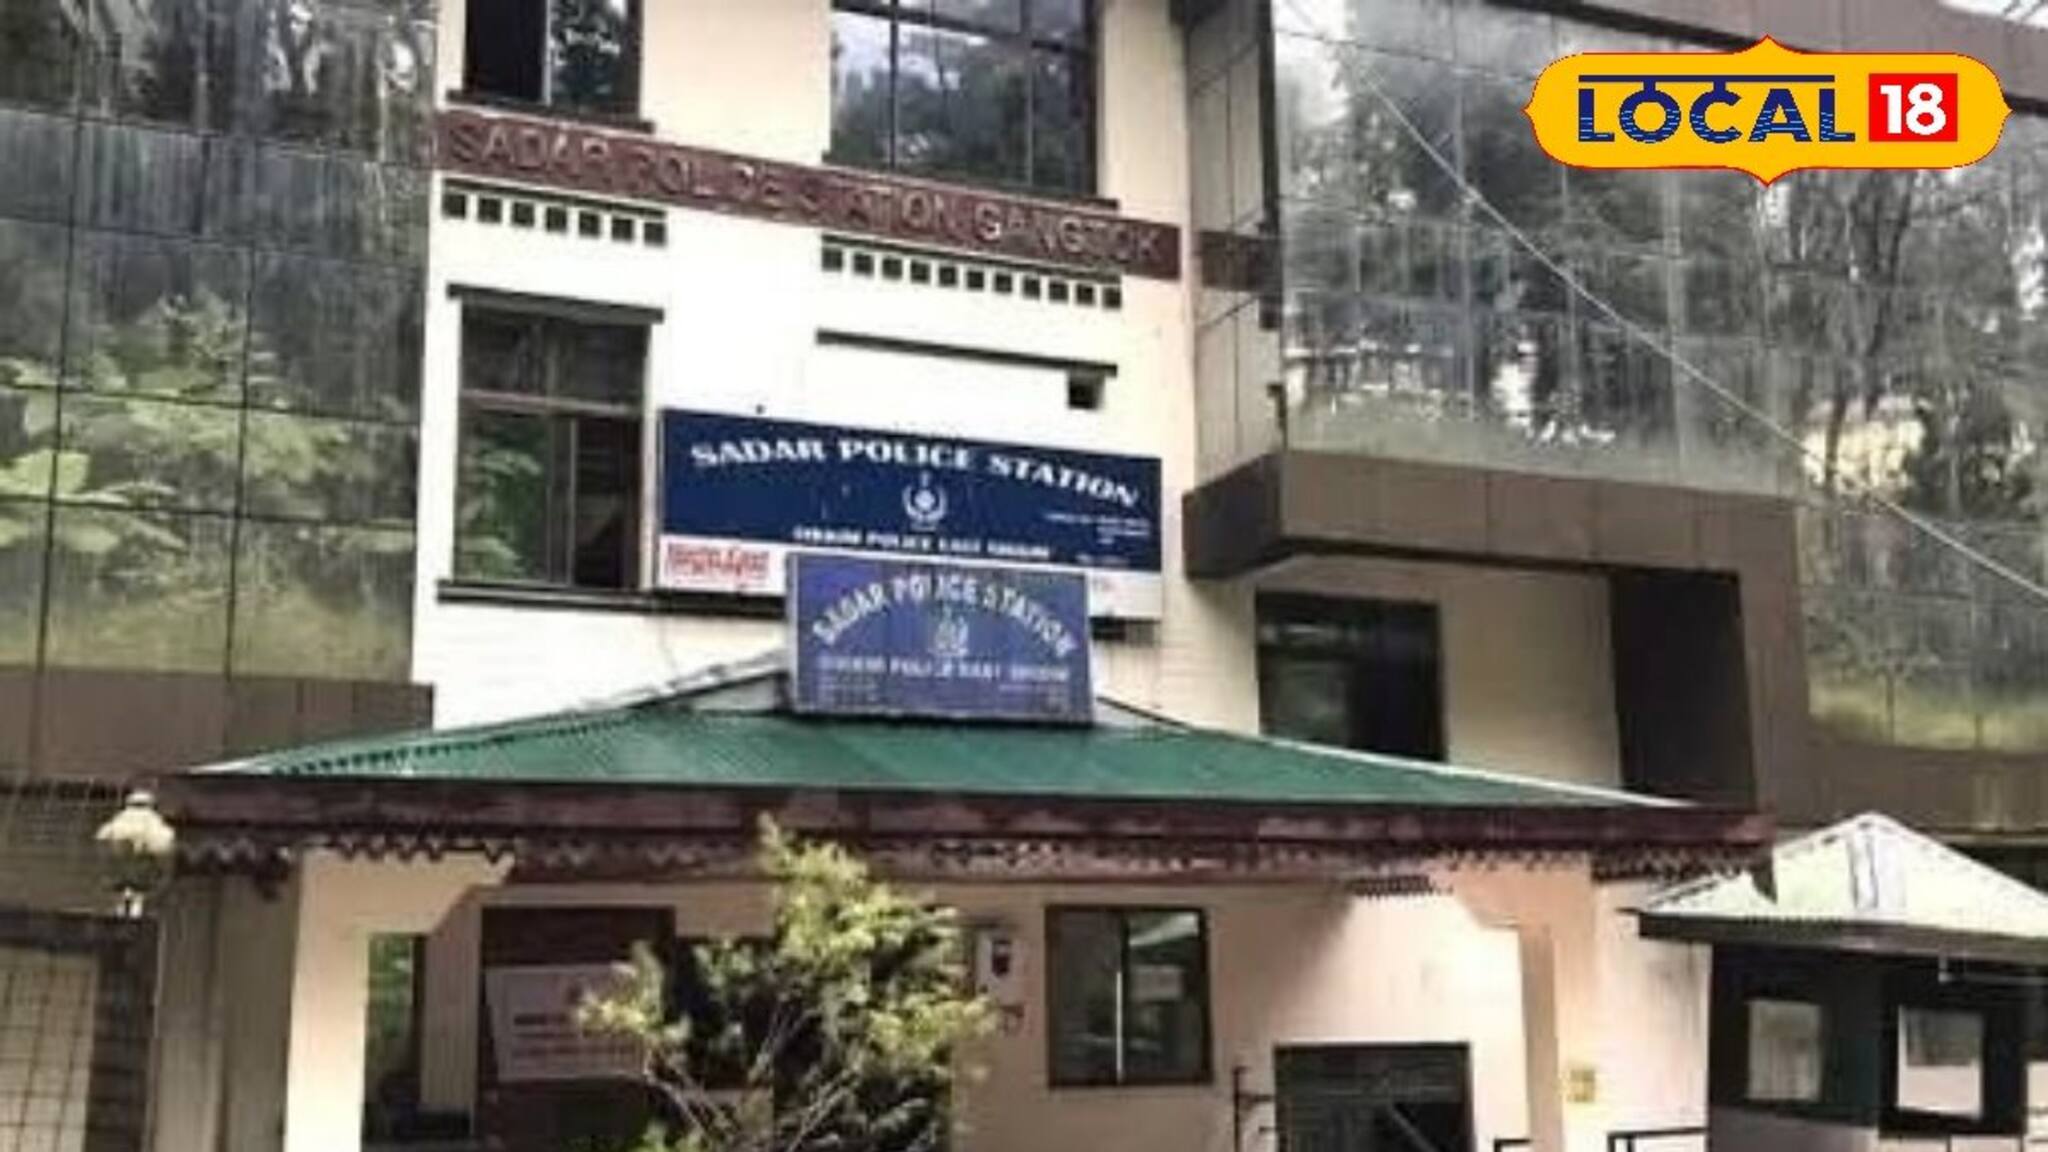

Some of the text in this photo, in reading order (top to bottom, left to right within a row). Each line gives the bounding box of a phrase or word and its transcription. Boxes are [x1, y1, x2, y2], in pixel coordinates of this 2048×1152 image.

[450, 121, 613, 183] SADAR
[627, 144, 790, 208] POLCE
[690, 437, 1142, 508] SADAR POLICE STATION
[812, 581, 888, 647] SADAR
[983, 584, 1080, 660] STATION
